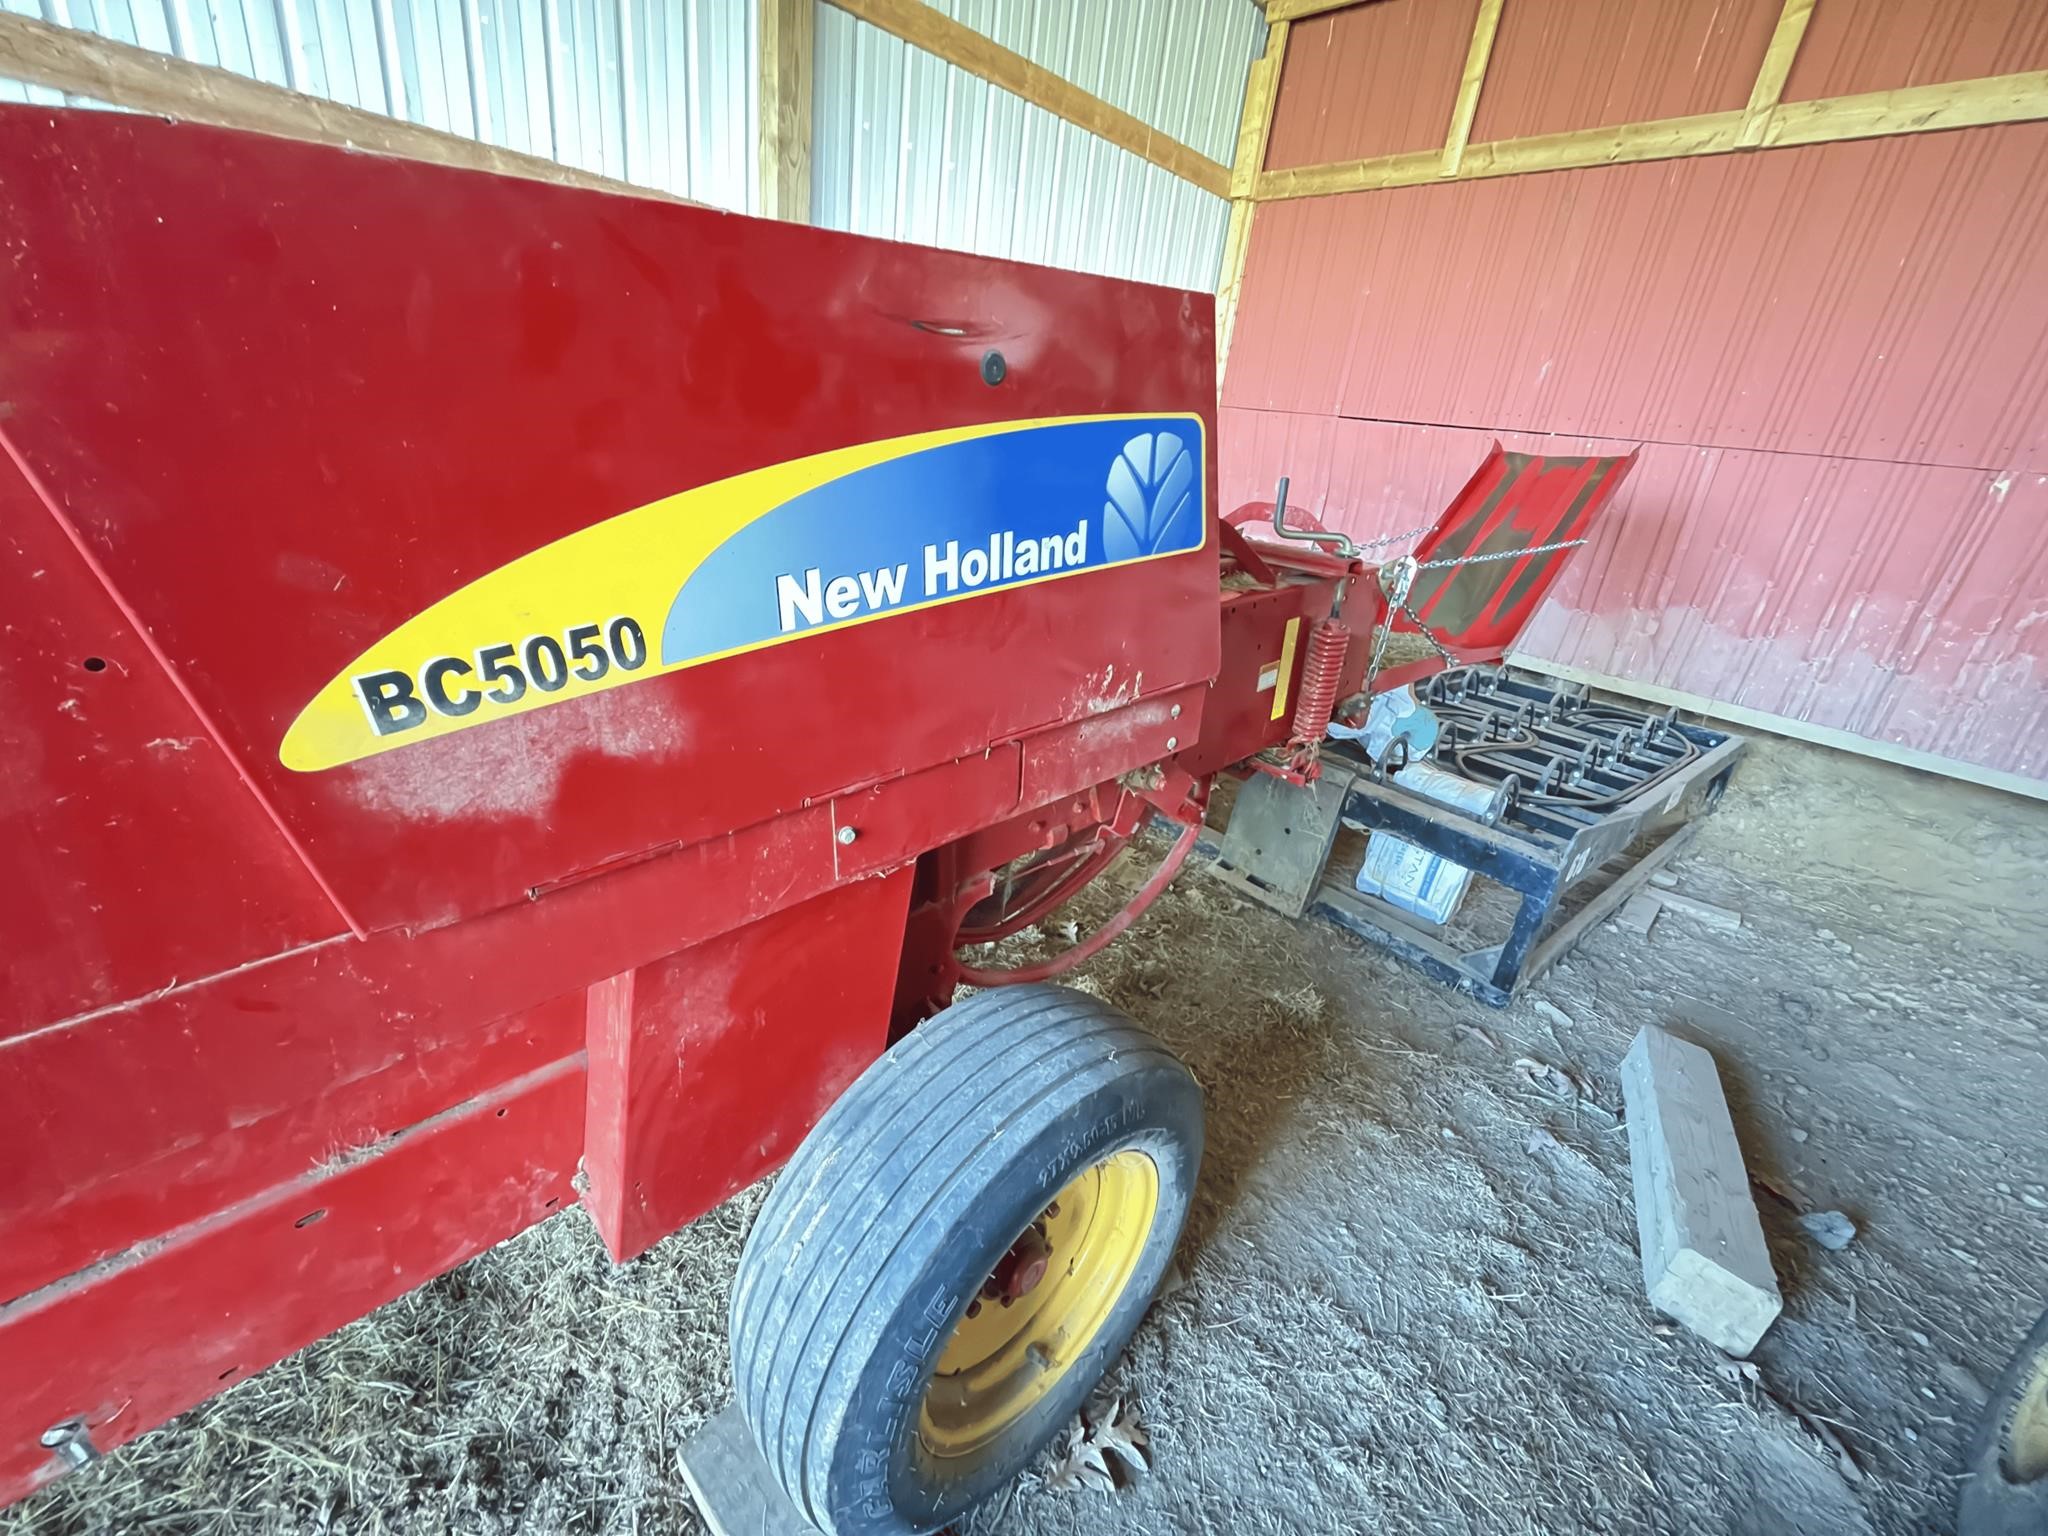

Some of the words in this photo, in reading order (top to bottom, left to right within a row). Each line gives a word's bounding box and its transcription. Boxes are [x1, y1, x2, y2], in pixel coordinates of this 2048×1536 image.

[776, 563, 909, 632] New
[923, 519, 1089, 597] Holland
[352, 616, 647, 737] BC5050
[1404, 849, 1427, 889] TAN
